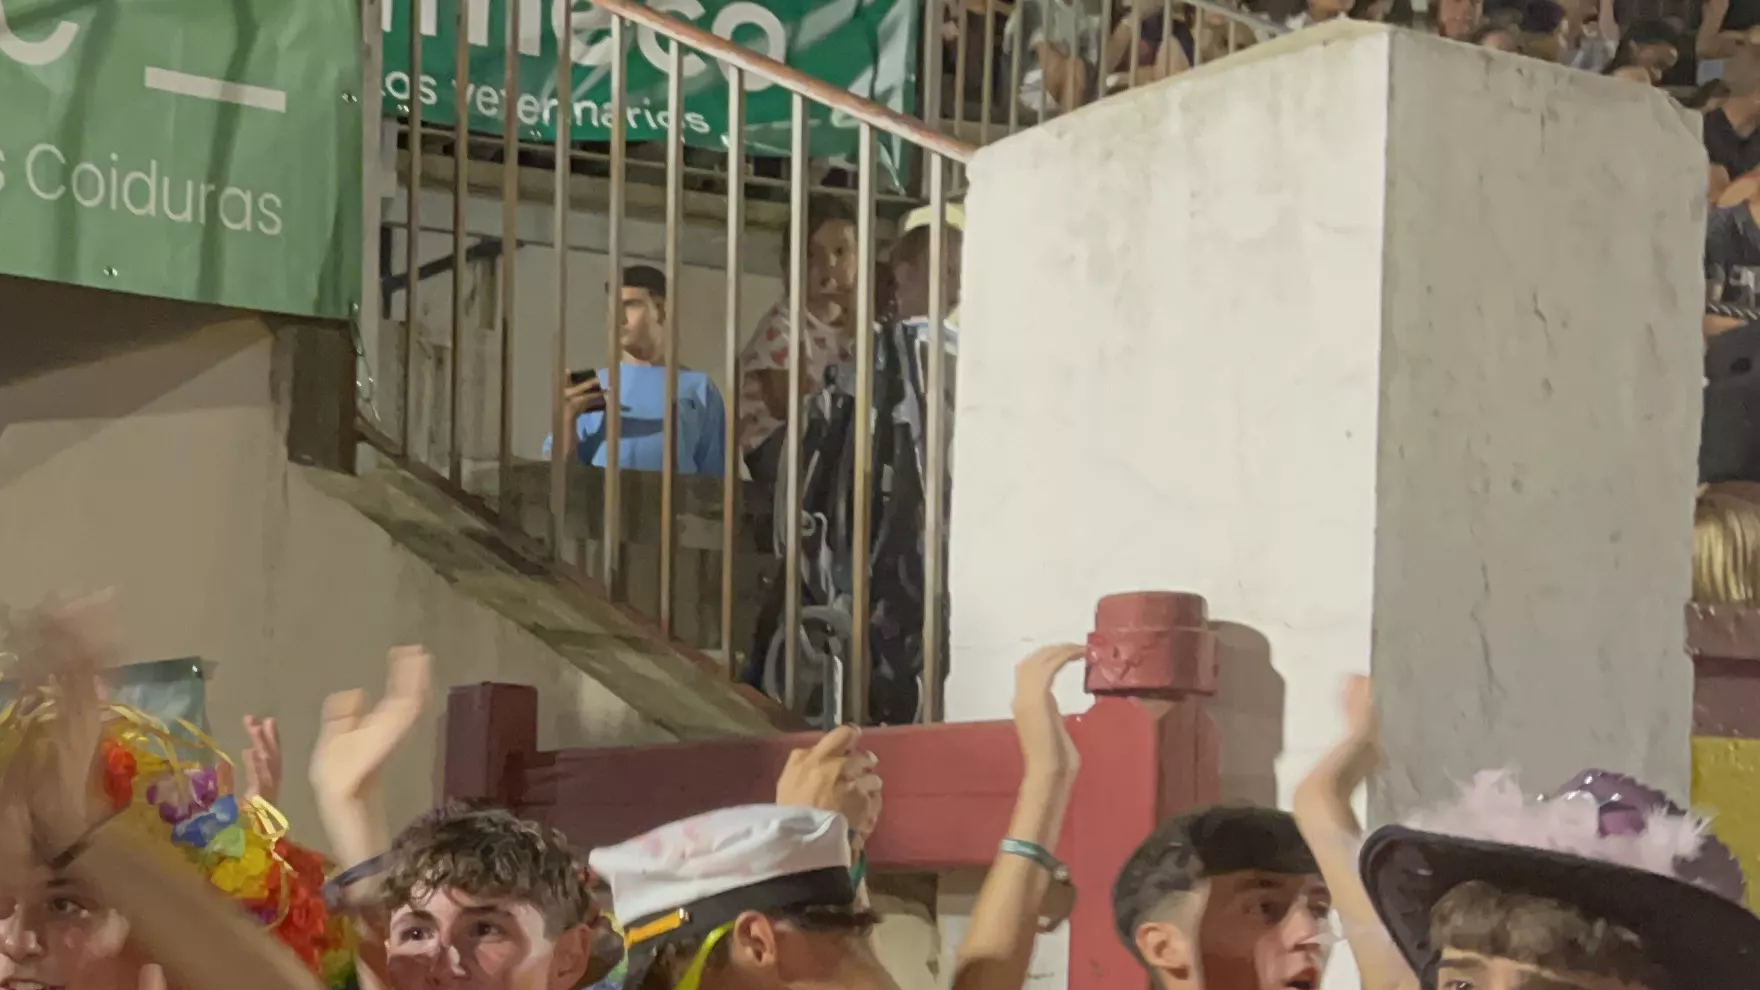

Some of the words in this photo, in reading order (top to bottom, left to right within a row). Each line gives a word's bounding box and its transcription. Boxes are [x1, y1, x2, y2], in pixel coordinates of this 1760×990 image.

[381, 70, 438, 106] os
[452, 78, 711, 134] veernarios
[25, 143, 284, 237] Coiduras
